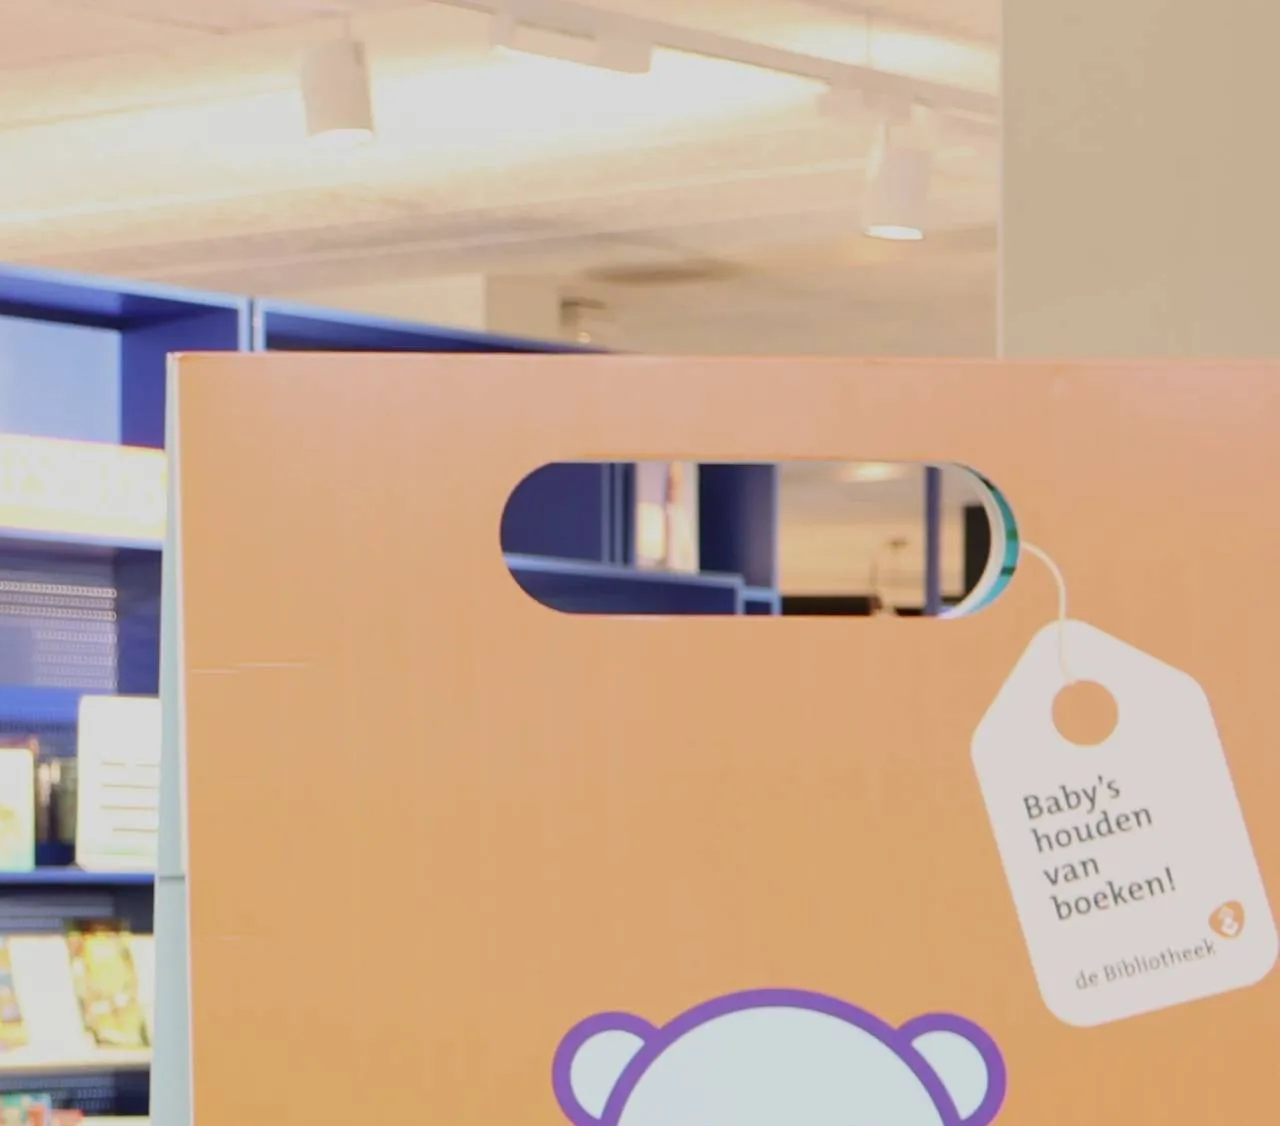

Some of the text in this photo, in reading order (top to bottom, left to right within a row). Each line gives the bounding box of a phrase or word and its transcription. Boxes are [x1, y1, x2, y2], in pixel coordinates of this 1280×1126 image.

[1023, 775, 1120, 820] Baby's
[1032, 806, 1153, 852] houden
[1043, 857, 1100, 886] van
[1050, 867, 1176, 920] boeken!
[1076, 938, 1216, 989] de Bibliotheek
